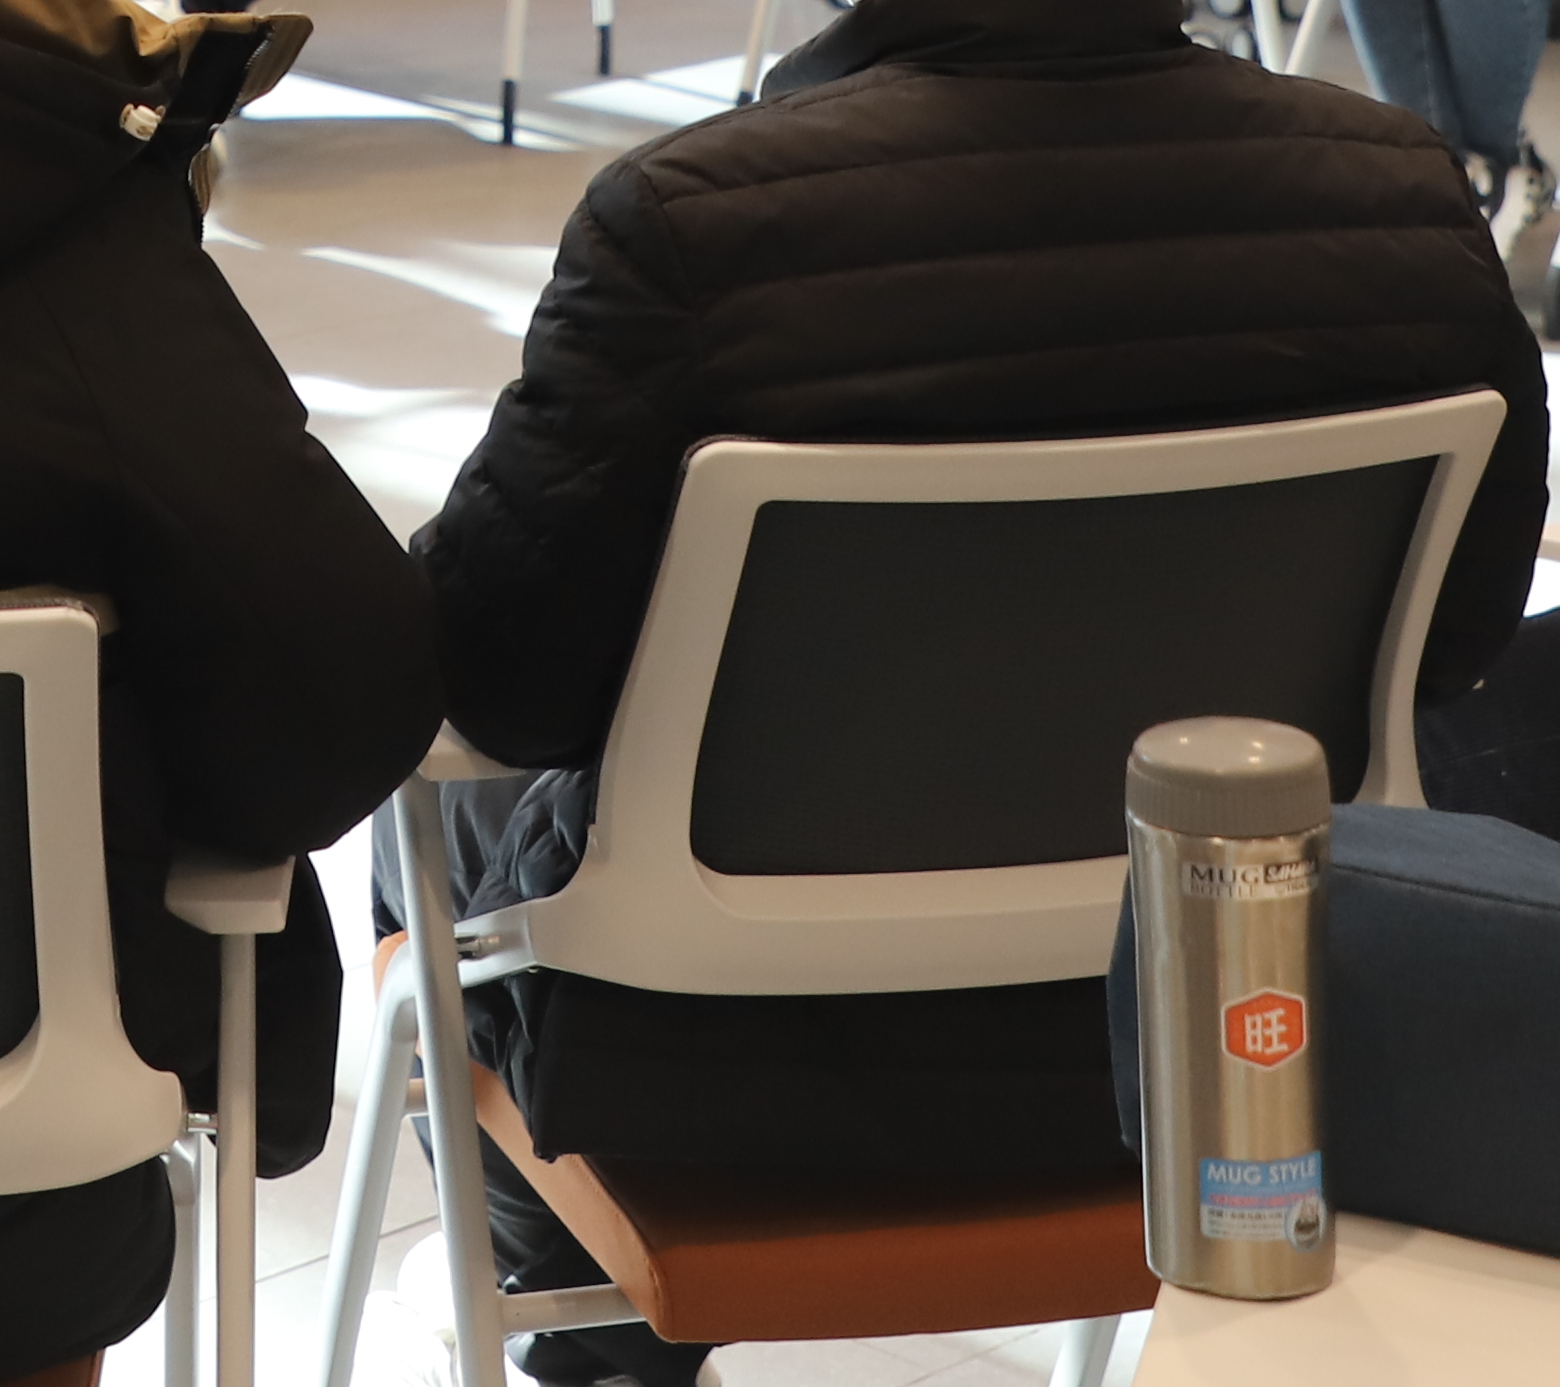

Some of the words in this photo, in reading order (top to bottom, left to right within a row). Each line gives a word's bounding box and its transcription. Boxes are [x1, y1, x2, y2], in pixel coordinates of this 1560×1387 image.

[1191, 864, 1259, 884] MUG
[1244, 1008, 1289, 1056] 旺
[1207, 1162, 1262, 1186] MUG
[1268, 1156, 1316, 1184] STYLE
